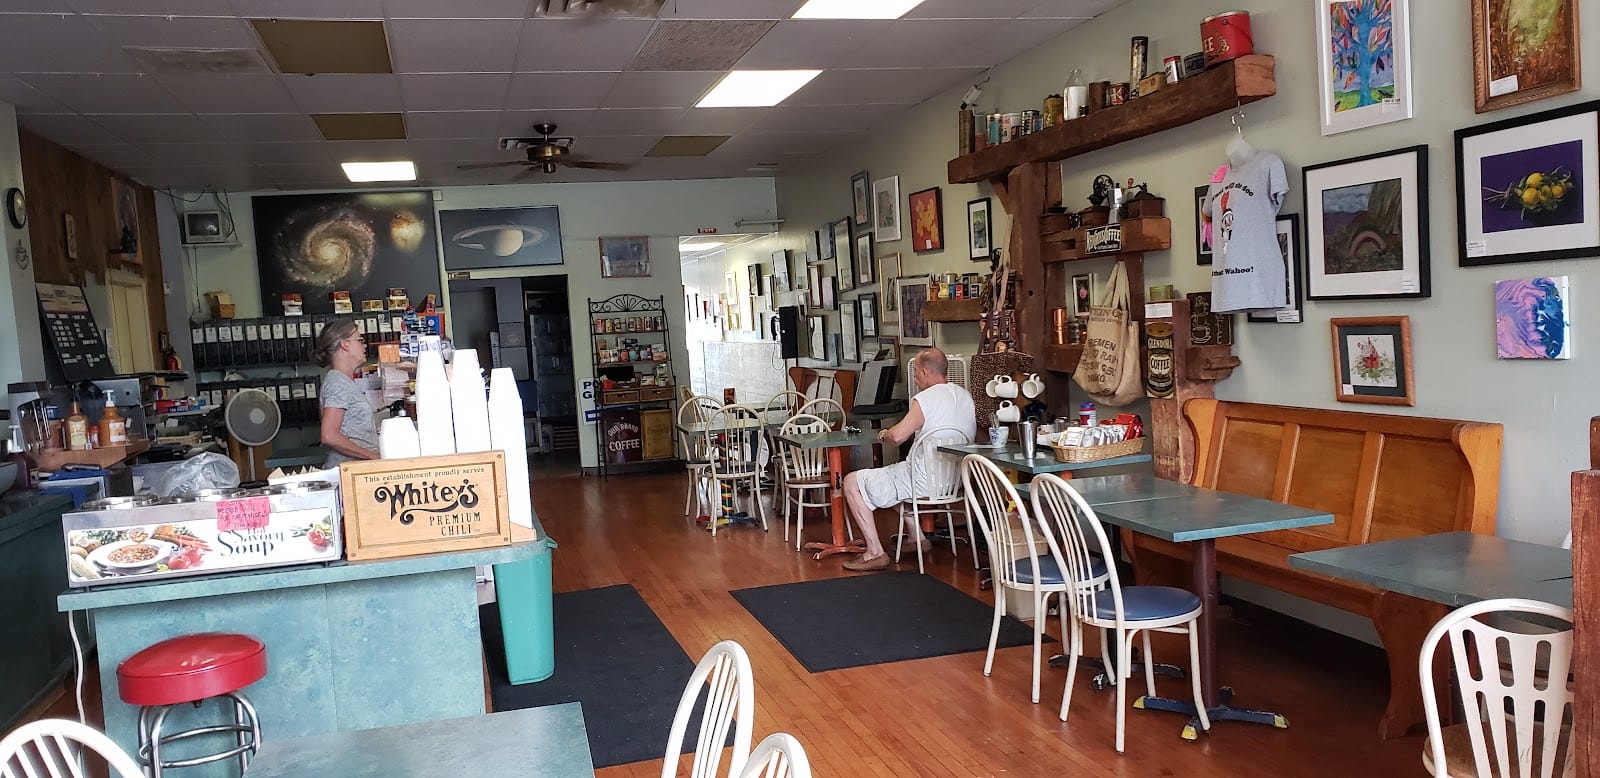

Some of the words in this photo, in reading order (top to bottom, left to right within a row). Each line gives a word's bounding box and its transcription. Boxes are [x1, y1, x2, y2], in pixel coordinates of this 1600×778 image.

[1151, 357, 1170, 370] COFFEE
[609, 438, 640, 452] COFFEE
[365, 475, 381, 484] This
[382, 471, 432, 481] establishment
[434, 469, 460, 478] proudly
[462, 467, 485, 475] serves
[375, 478, 479, 525] Whitey's
[429, 511, 481, 526] PREMIUM
[441, 524, 472, 536] CHILI
[217, 530, 275, 556] Soup
